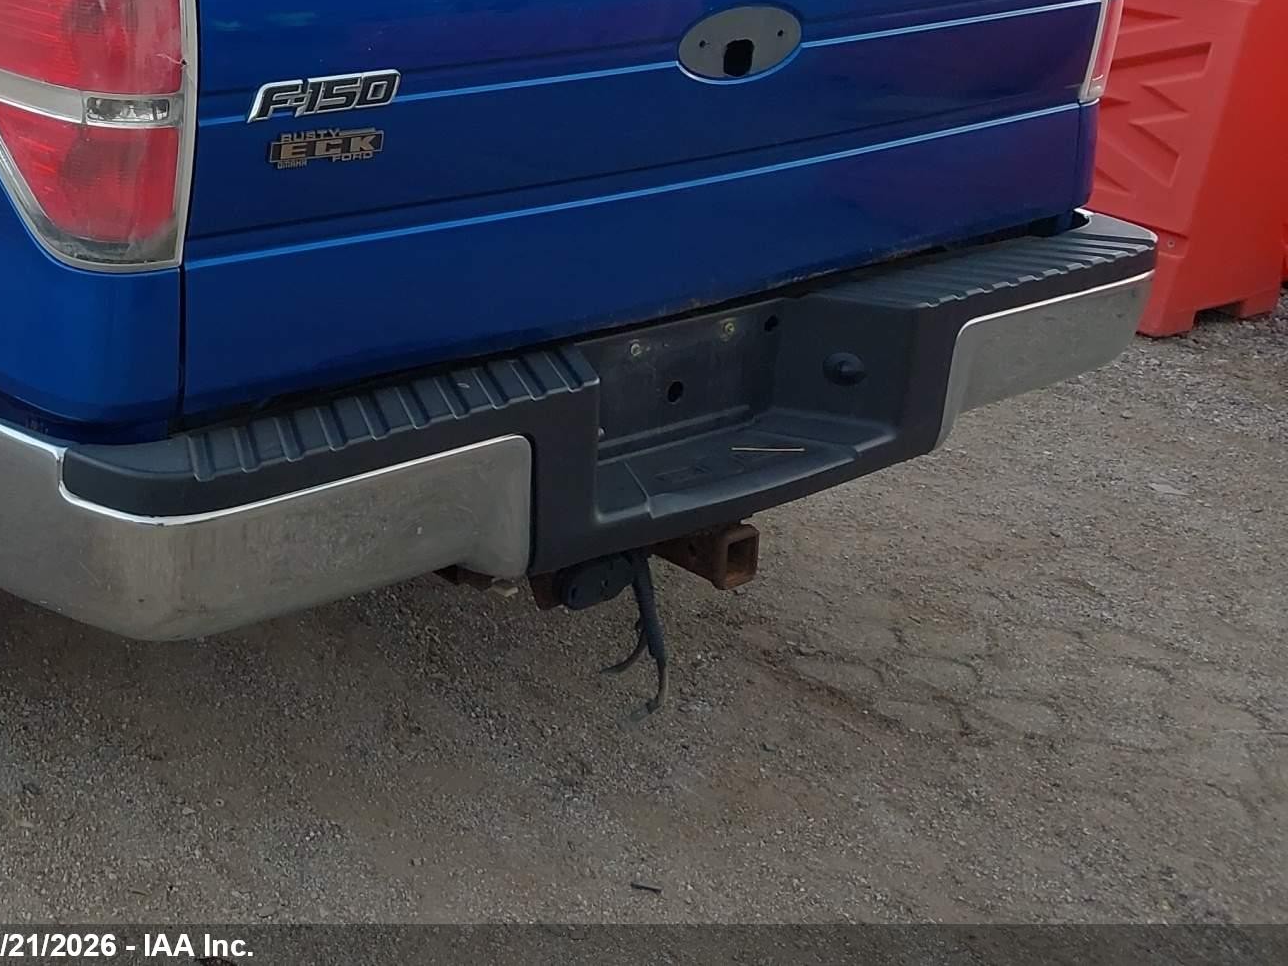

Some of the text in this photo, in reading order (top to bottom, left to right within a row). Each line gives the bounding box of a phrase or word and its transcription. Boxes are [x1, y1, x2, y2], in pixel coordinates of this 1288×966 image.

[247, 68, 402, 124] F-150
[280, 128, 341, 142] RUSTY
[279, 135, 377, 160] ECK
[332, 150, 374, 162] FORD
